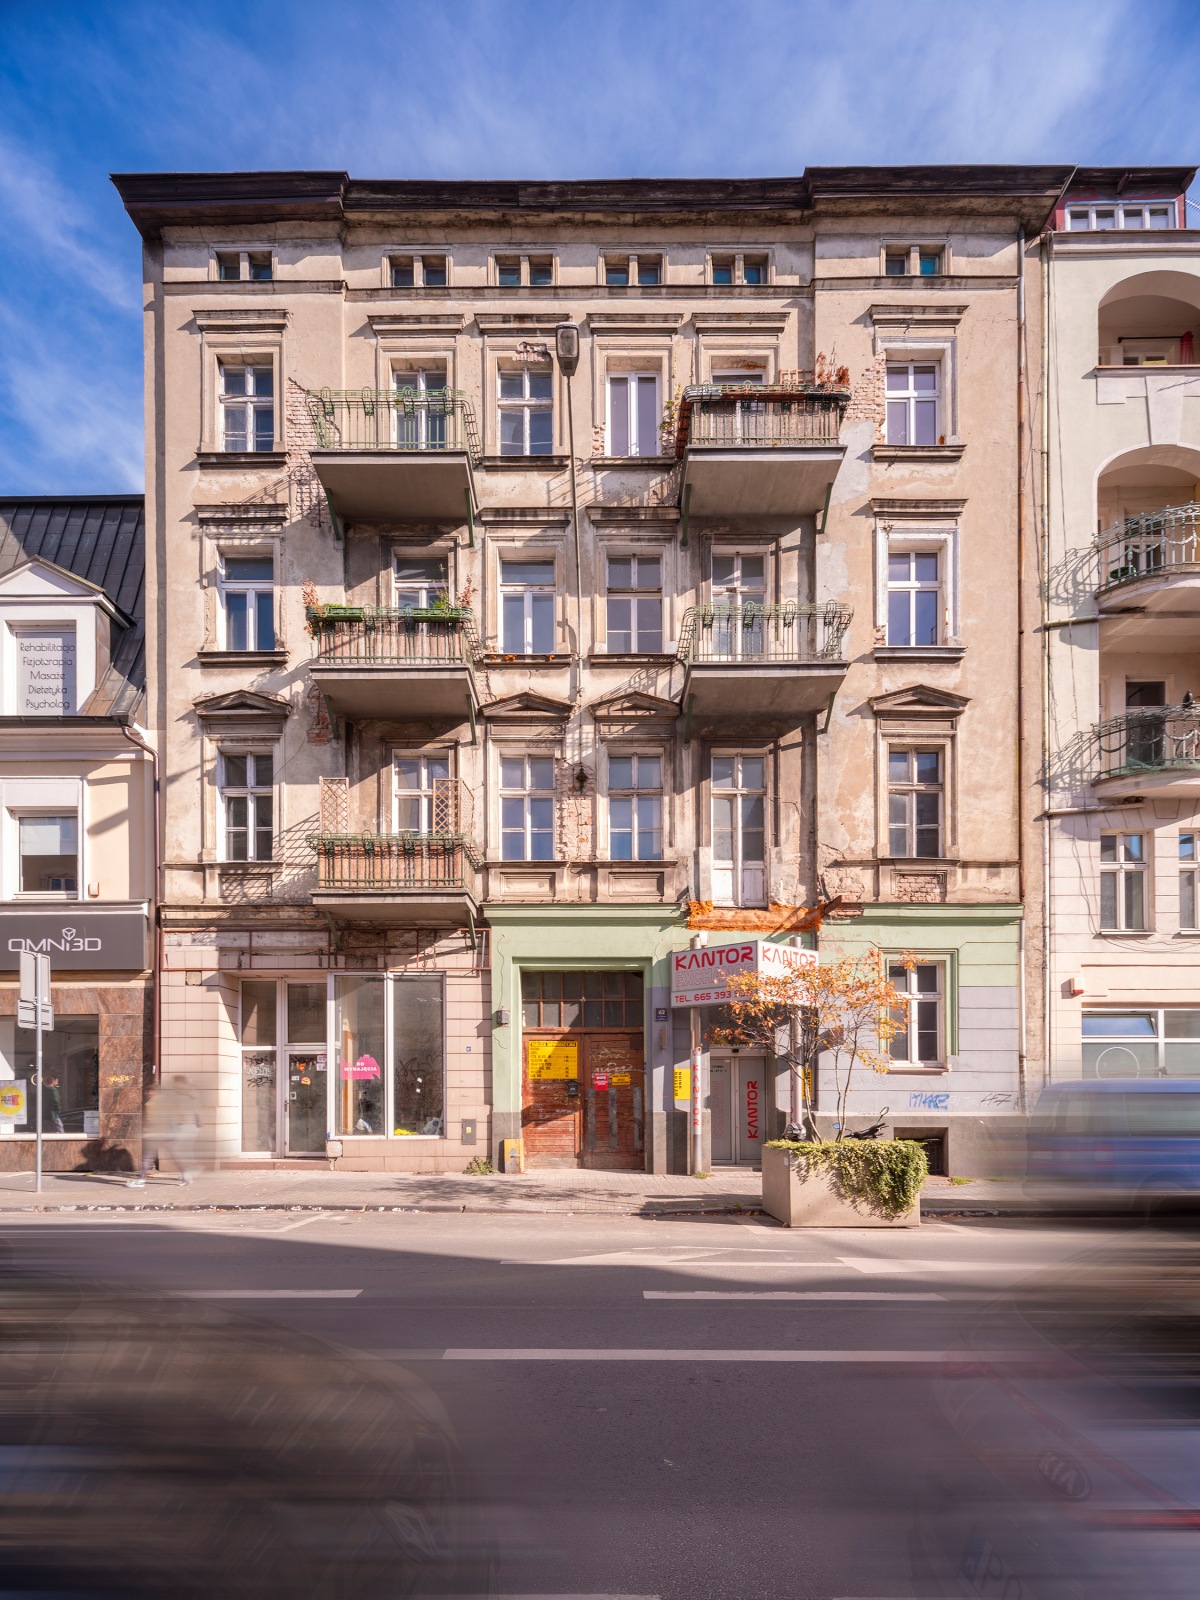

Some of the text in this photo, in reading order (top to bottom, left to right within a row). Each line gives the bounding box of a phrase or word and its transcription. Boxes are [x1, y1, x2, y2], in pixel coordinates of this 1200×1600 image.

[20, 642, 76, 653] Rehabilitacja
[22, 656, 73, 668] Fizjoterapia
[30, 670, 66, 680] Masaże
[28, 684, 68, 696] Dietetyka
[25, 698, 71, 710] Psycholog
[675, 945, 754, 971] KANTOR
[762, 945, 817, 969] KANTOR
[675, 994, 692, 1004] TEL.
[693, 992, 711, 1001] 665
[714, 990, 732, 1000] 393
[692, 1064, 700, 1127] KANTOR
[747, 1080, 759, 1139] KANTOR
